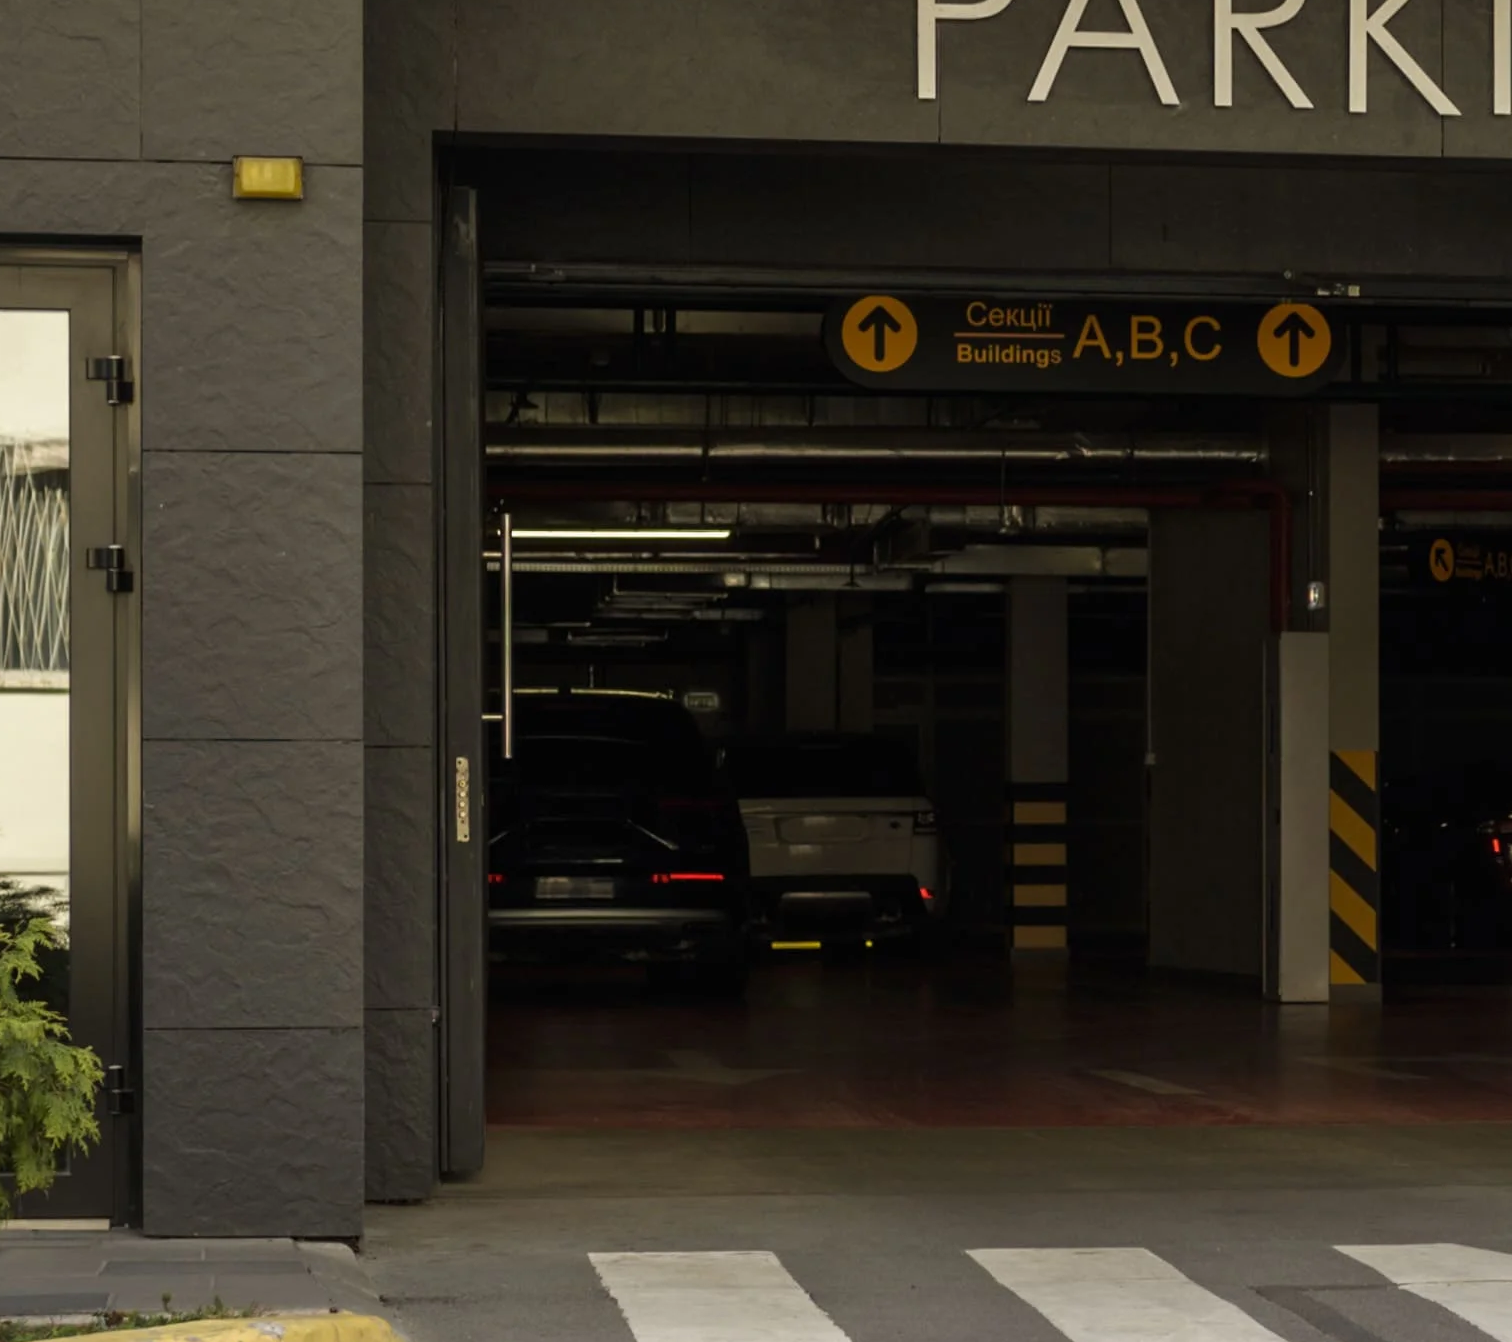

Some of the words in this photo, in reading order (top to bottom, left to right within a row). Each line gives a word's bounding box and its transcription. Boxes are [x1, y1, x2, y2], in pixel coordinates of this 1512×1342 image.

[965, 299, 1052, 330] Секції
[955, 341, 1063, 370] Buildings
[1071, 313, 1223, 368] A,B,C
